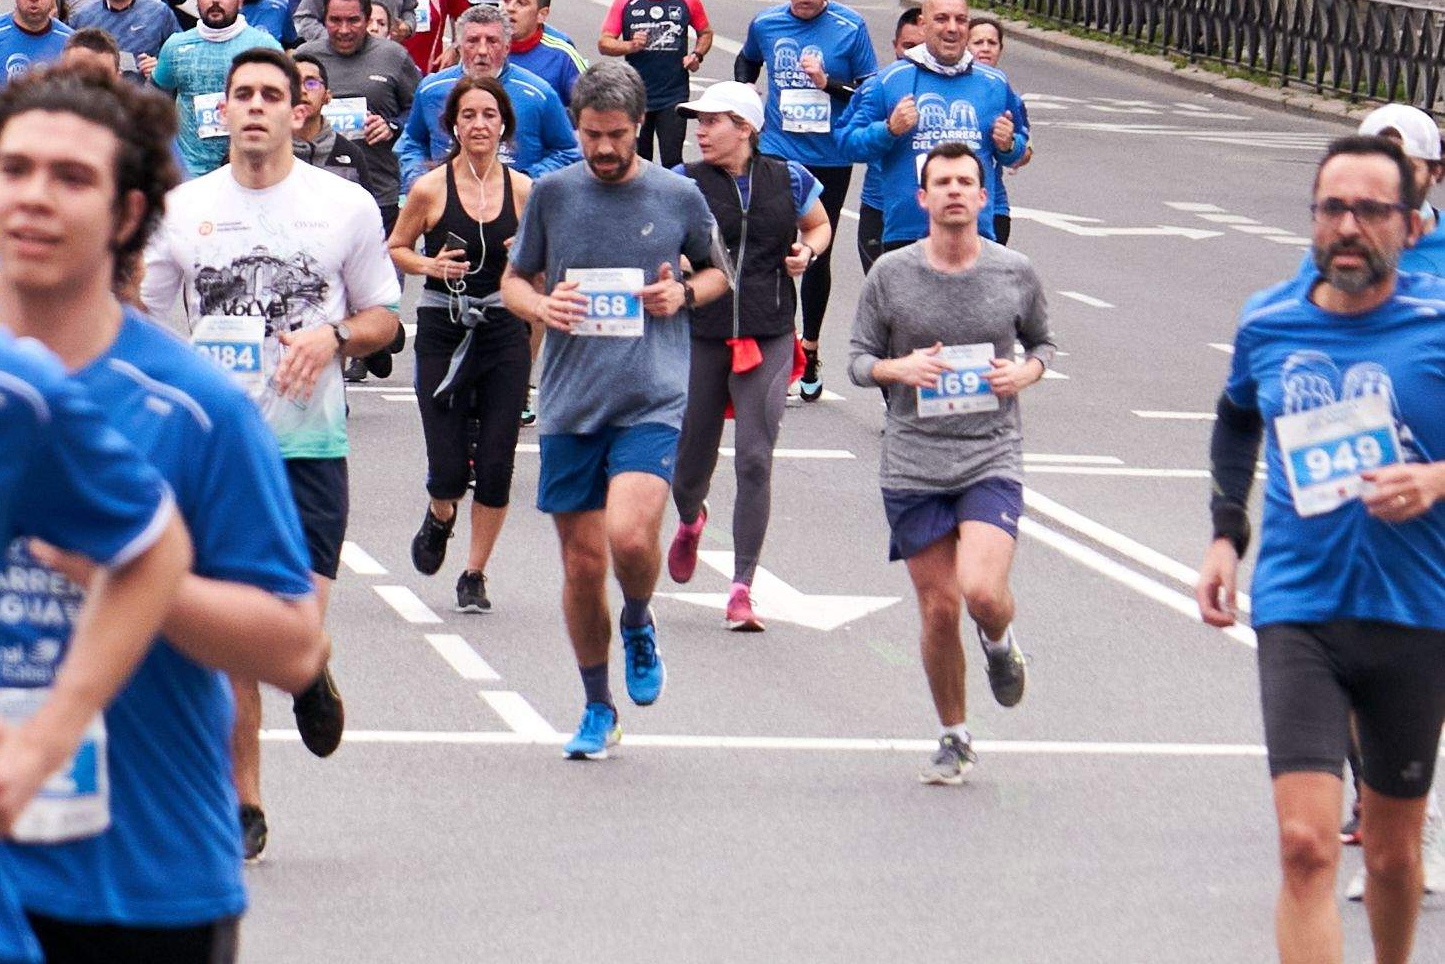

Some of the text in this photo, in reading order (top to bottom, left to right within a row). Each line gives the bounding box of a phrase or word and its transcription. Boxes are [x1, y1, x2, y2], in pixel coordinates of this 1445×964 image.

[912, 141, 934, 149] DEL
[933, 130, 982, 140] CARRERA
[587, 295, 627, 316] 168
[938, 372, 979, 395] 169
[1305, 436, 1382, 480] 949
